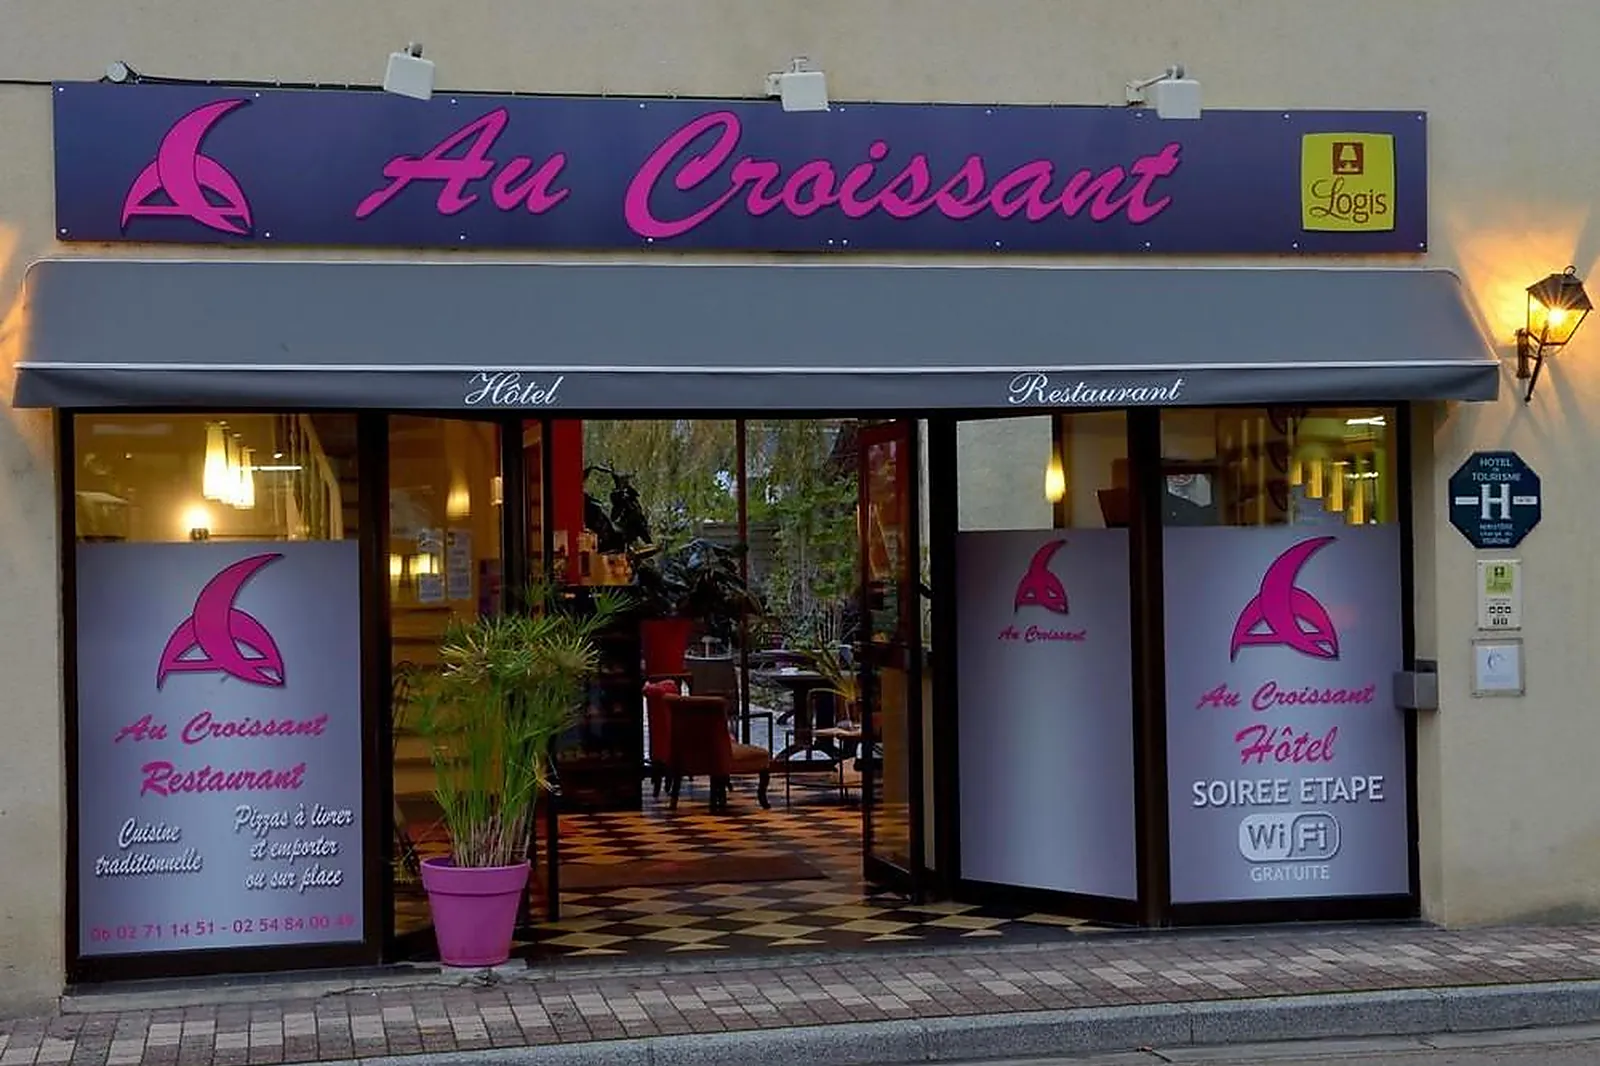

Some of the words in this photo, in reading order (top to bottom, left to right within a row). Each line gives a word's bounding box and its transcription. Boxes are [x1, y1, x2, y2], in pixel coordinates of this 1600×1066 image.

[355, 107, 569, 219] Au
[624, 109, 1182, 239] Croissant
[1309, 176, 1388, 224] Logis
[464, 372, 564, 405] Hôtel
[1008, 372, 1184, 404] Restaurant
[1472, 472, 1522, 482] TOURISME
[1480, 483, 1512, 520] H
[1197, 683, 1241, 710] Au
[1252, 681, 1376, 711] Croissant
[115, 714, 168, 743] Au
[181, 711, 328, 745] Croissant
[1235, 724, 1338, 765] Hôtel
[140, 761, 306, 797] Restaurant
[1192, 780, 1291, 806] SOIREE
[1300, 775, 1384, 801] ETAPE
[118, 818, 181, 848] Cuisine
[234, 804, 289, 838] Pizzas
[311, 803, 353, 828] livrer
[1245, 820, 1331, 853] WiFi
[95, 848, 203, 877] traditionnelle
[250, 839, 267, 858] et
[269, 836, 338, 864] emporter
[245, 872, 266, 889] ou
[270, 870, 297, 888] sur
[299, 863, 343, 893] place
[1251, 865, 1331, 882] GRATUITE
[117, 924, 136, 940] 02
[143, 923, 162, 938] 71
[172, 922, 190, 938] 14
[196, 920, 214, 936] 51
[233, 919, 254, 933] 02
[259, 918, 278, 932] 54
